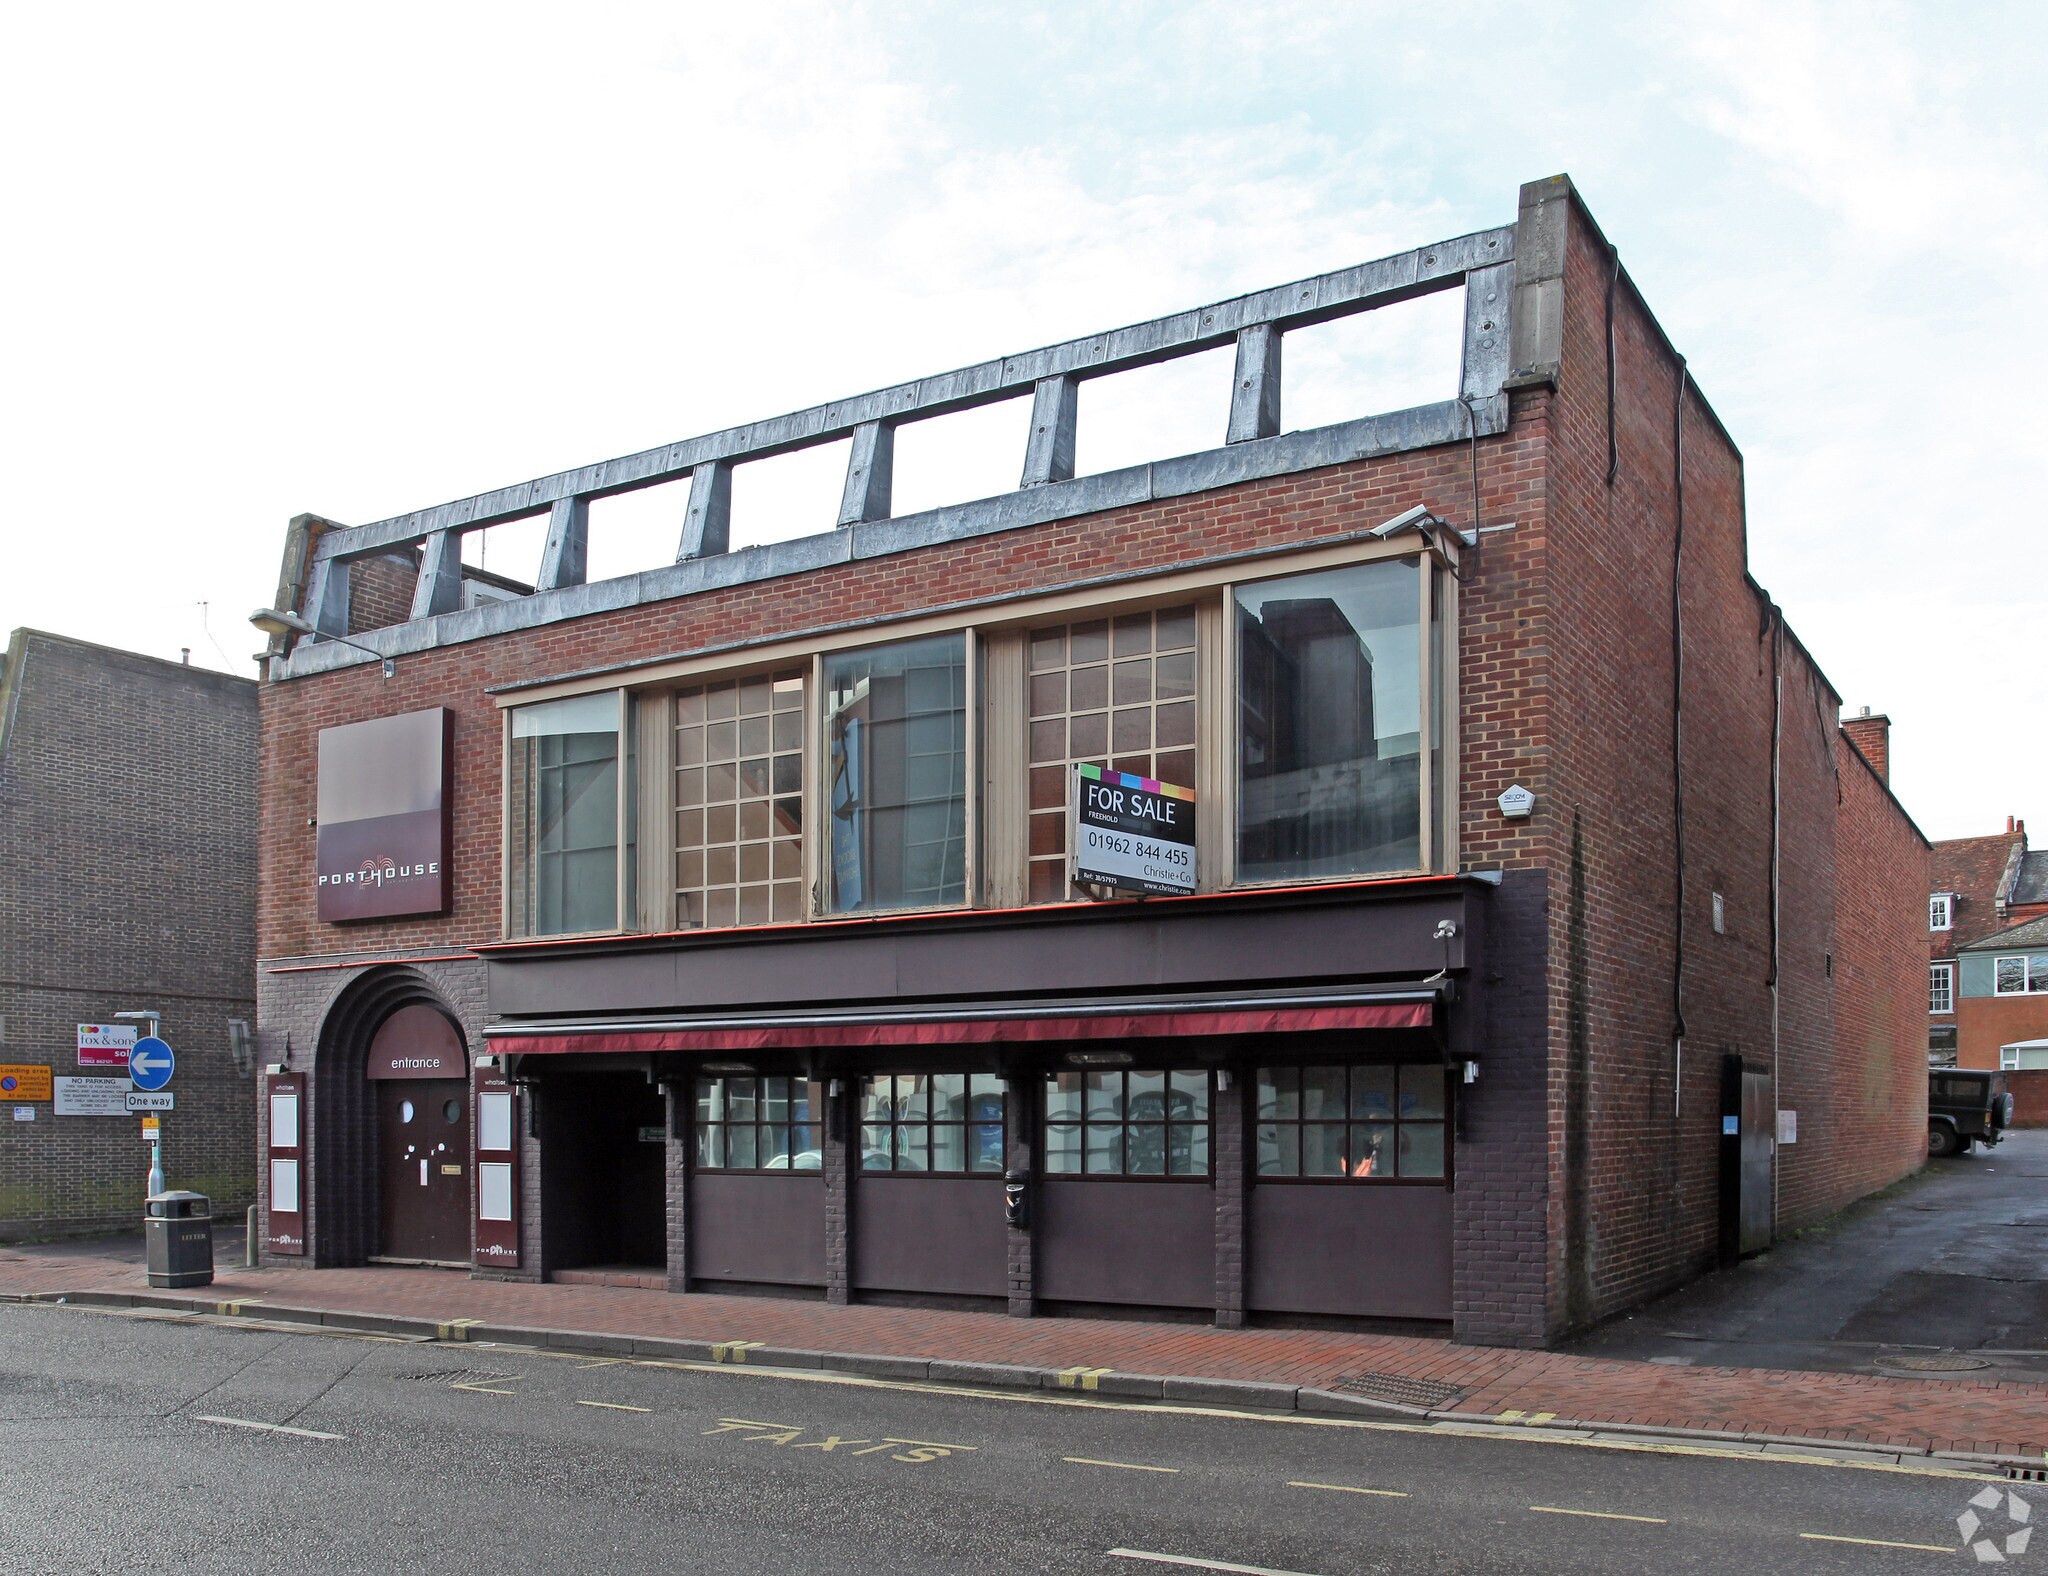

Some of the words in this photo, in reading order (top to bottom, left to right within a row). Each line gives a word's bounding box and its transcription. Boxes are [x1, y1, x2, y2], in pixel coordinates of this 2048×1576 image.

[1088, 784, 1124, 813] FOR
[1130, 794, 1176, 824] SALE
[1088, 810, 1119, 823] FREEHOLD
[1089, 831, 1130, 855] 01962
[1135, 841, 1161, 861] 844
[1164, 849, 1188, 866] 455
[318, 862, 439, 888] PORTHOUSE
[1143, 882, 1191, 895] www.christie.com
[81, 1035, 100, 1045] fox
[101, 1035, 111, 1046] &
[113, 1038, 136, 1046] sons
[114, 1049, 130, 1057] sol
[391, 1057, 441, 1069] entrance
[128, 1096, 149, 1106] One
[151, 1098, 171, 1107] way
[181, 1233, 207, 1241] LITTER
[701, 1422, 952, 1463] TAXIS
